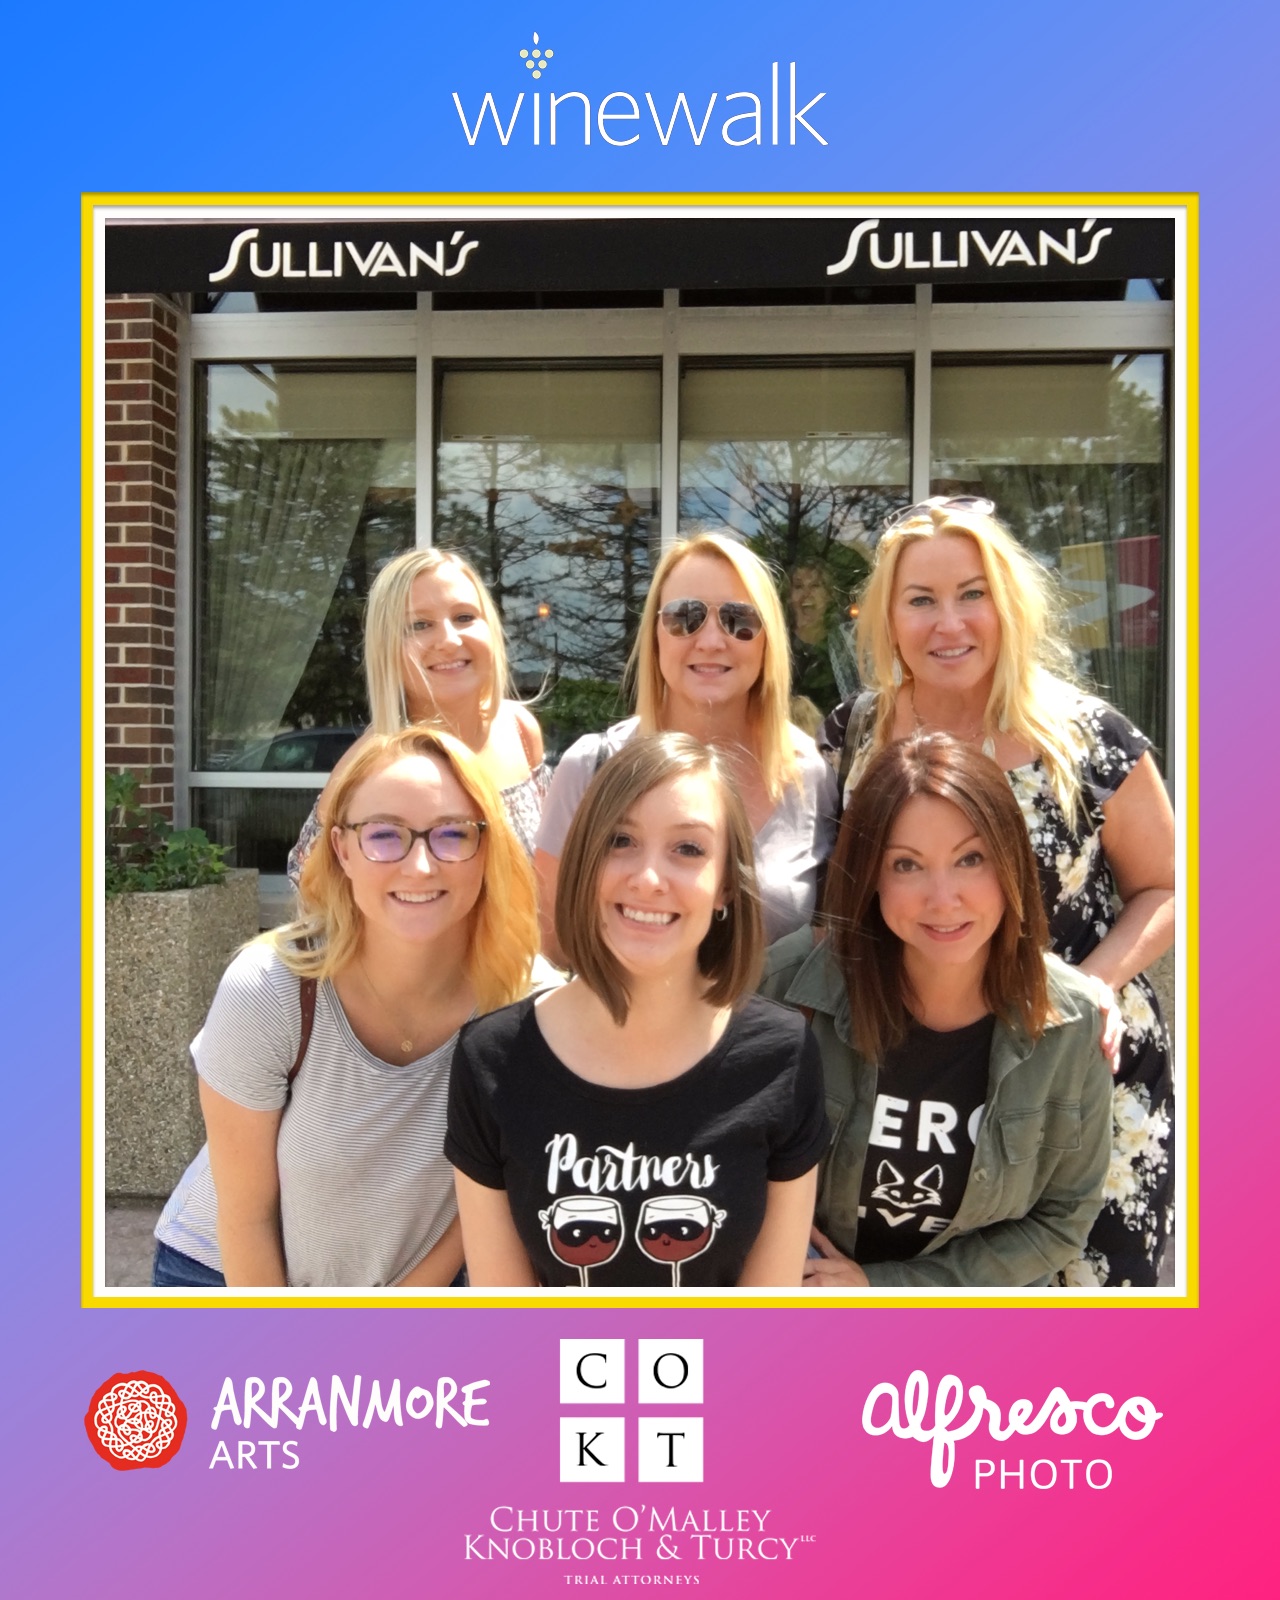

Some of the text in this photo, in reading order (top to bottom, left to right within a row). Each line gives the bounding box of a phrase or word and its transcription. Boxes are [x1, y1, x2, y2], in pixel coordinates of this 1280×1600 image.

[208, 228, 479, 283] SULLIVAN'S
[826, 219, 1113, 276] SULLIVAN'S
[545, 1132, 721, 1195] Partners
